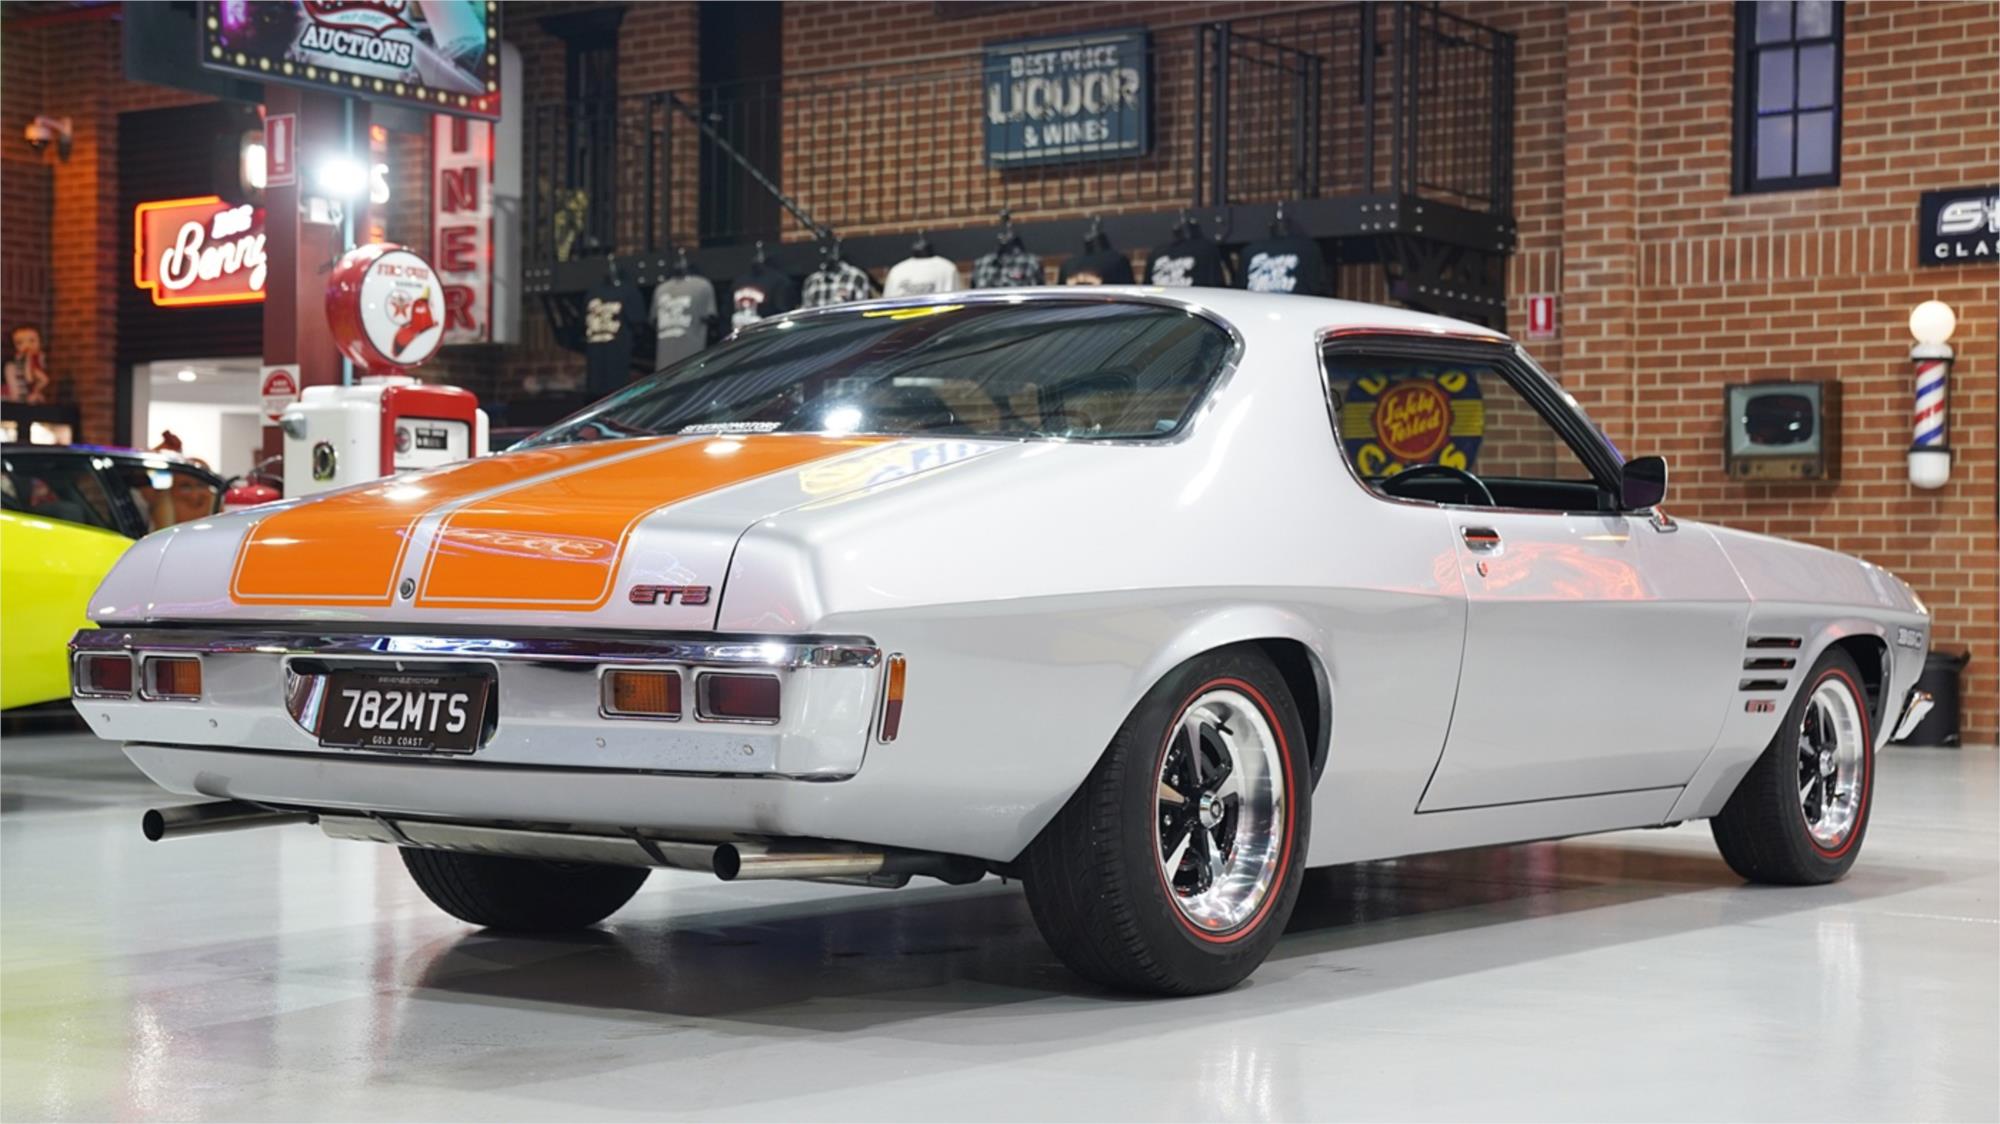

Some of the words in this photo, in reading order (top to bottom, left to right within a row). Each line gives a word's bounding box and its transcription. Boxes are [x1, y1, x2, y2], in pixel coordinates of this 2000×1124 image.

[302, 25, 411, 67] AUCTIONS
[1009, 51, 1058, 78] BEST
[1060, 45, 1119, 71] PRICE
[988, 68, 1140, 124] LIQUOR
[1024, 125, 1038, 148] &
[1042, 118, 1110, 146] WINES
[342, 689, 469, 733] 782MTS
[372, 735, 393, 745] GOLD
[397, 736, 424, 746] COAST
